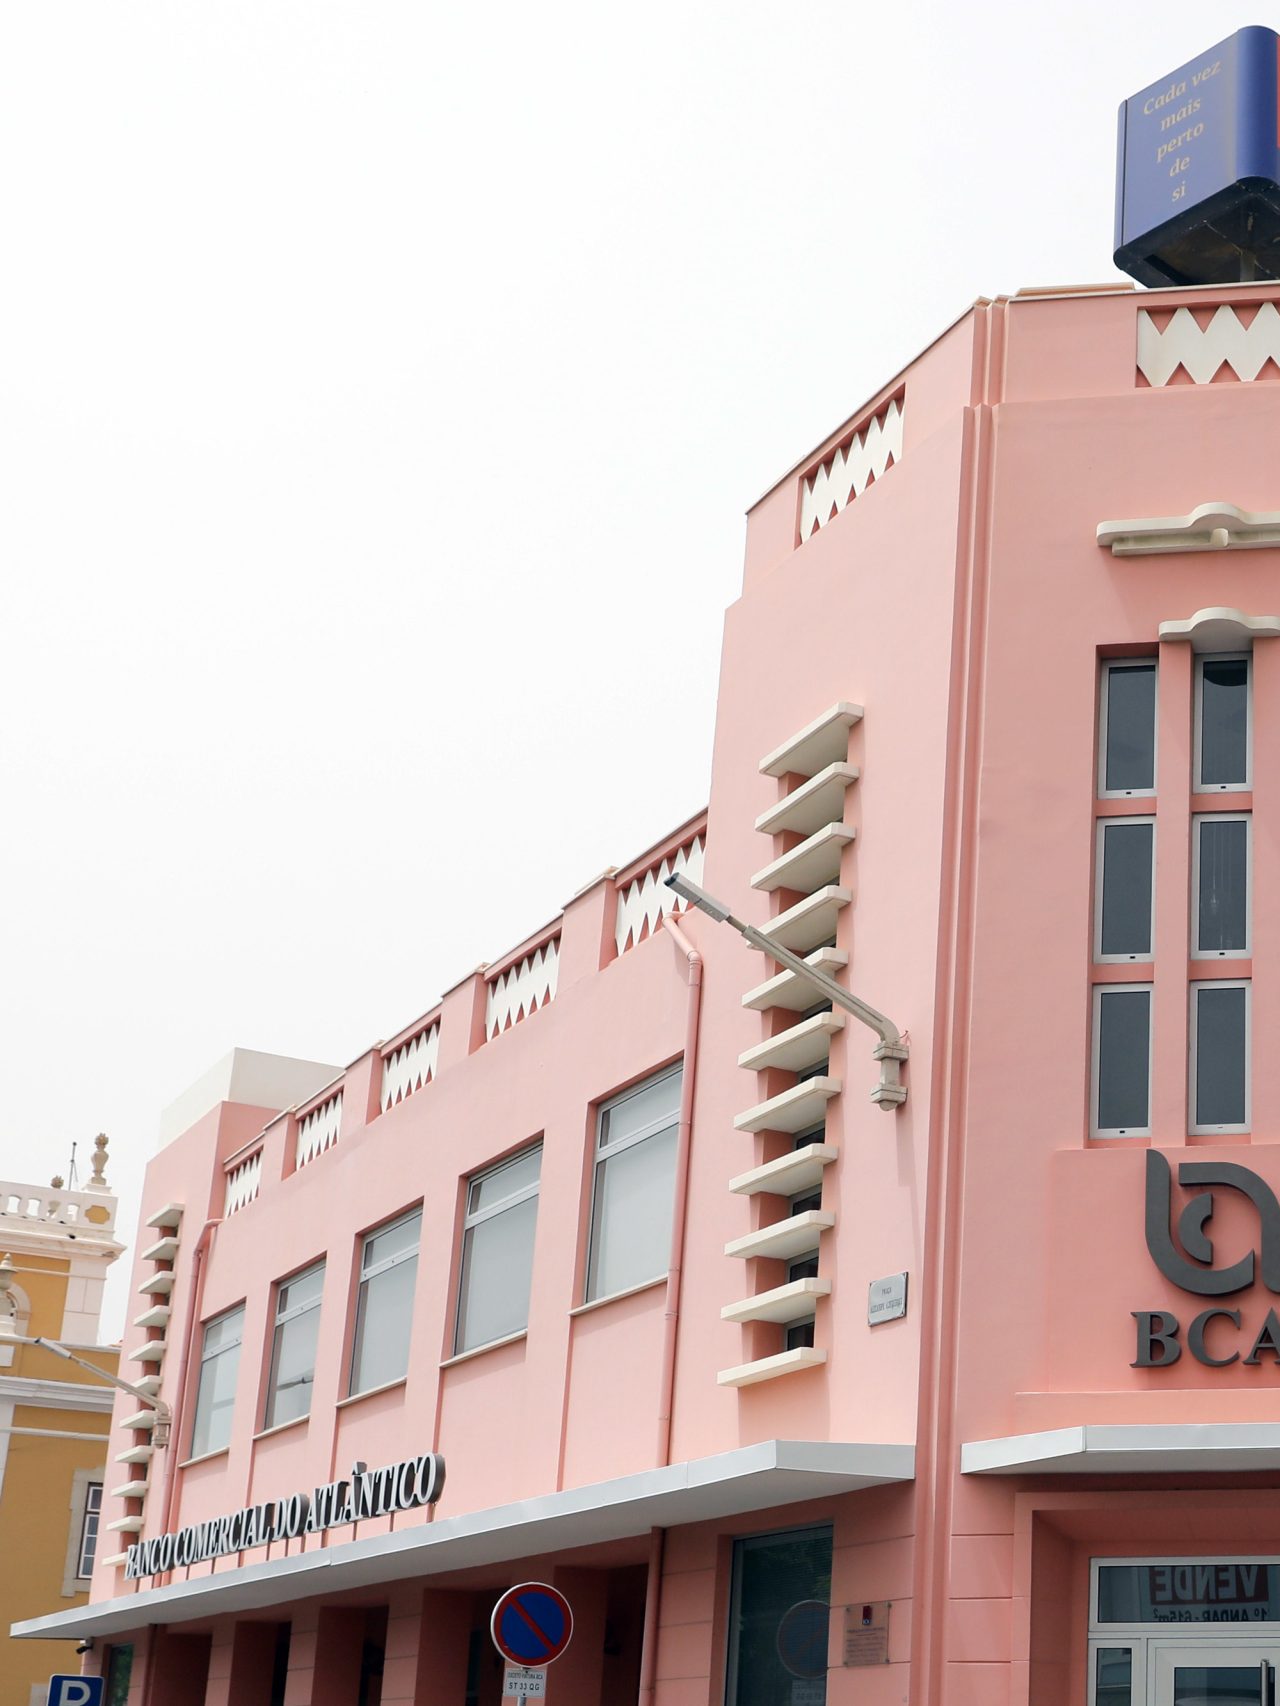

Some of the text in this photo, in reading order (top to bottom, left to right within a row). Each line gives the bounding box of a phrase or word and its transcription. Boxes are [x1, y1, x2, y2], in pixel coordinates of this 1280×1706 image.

[1143, 60, 1221, 115] Cada vez
[1160, 98, 1202, 131] mais
[1156, 122, 1205, 163] perto
[1169, 156, 1190, 177] de
[1171, 180, 1186, 202] si
[124, 1452, 447, 1581] BANCO COMERCIAL DO ATLÂNTICO
[59, 1680, 91, 1706] P
